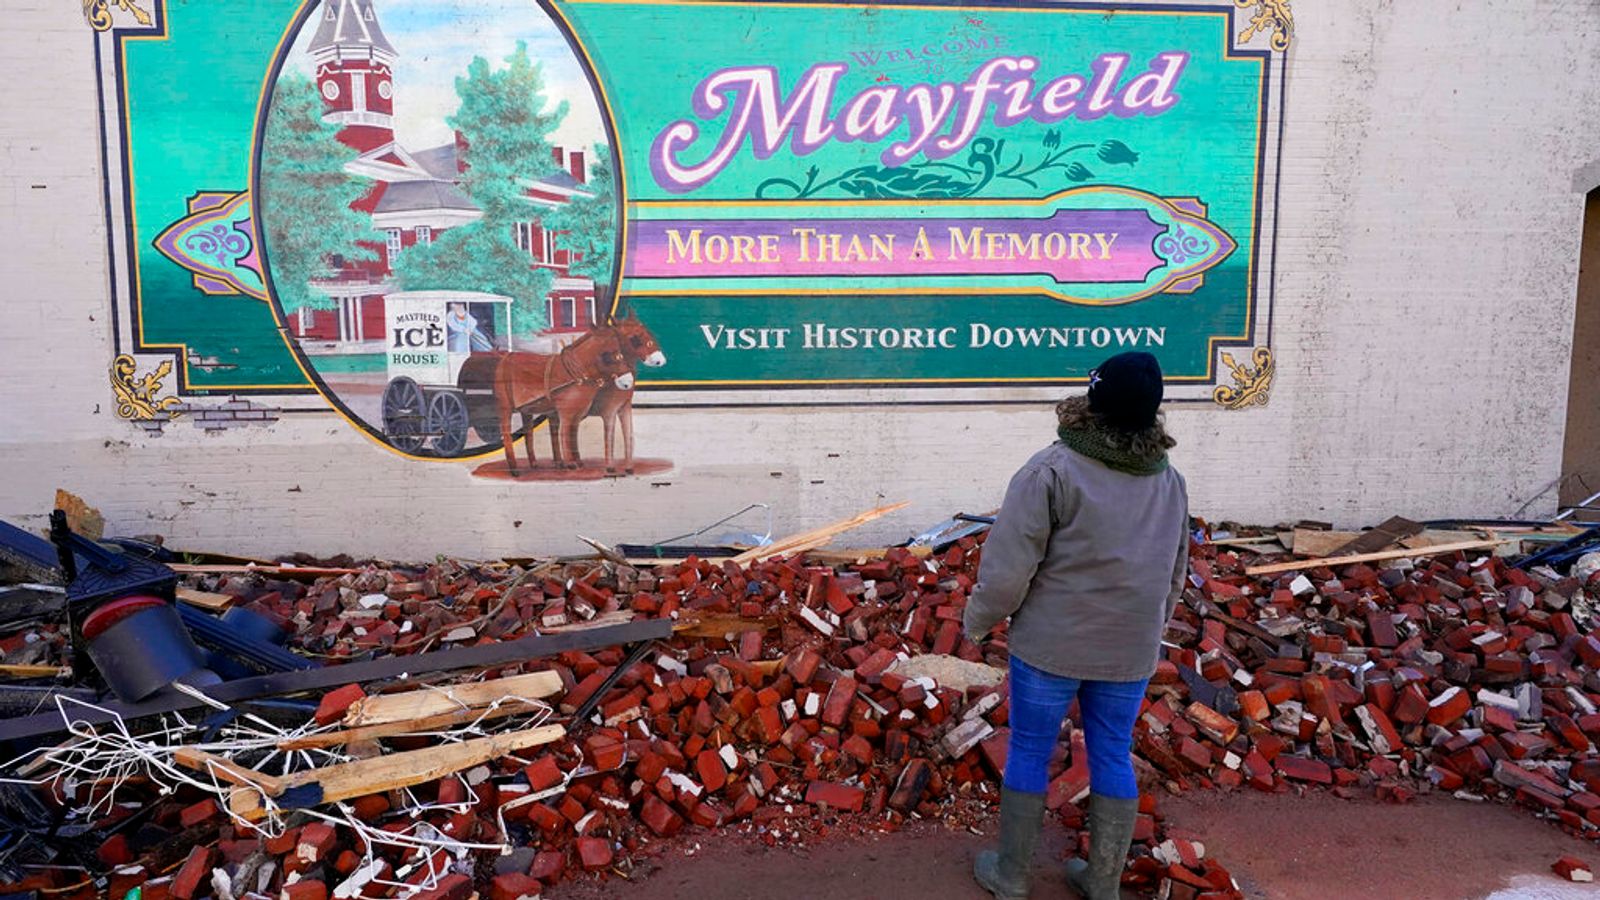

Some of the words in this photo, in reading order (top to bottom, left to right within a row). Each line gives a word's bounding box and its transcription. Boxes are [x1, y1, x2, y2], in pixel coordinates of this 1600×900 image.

[850, 36, 1010, 67] WELCOME
[649, 50, 1191, 193] Mayfield
[666, 229, 780, 263] MORE
[793, 228, 895, 262] THAN
[909, 227, 935, 260] A
[948, 227, 1119, 261] MEMORY
[396, 312, 440, 324] MAYFIELD
[393, 327, 444, 348] ICE
[700, 324, 790, 349] VISIT
[802, 323, 957, 349] HISTORIC
[969, 323, 1166, 348] DOWNTOWN
[393, 353, 439, 365] HOUSE
